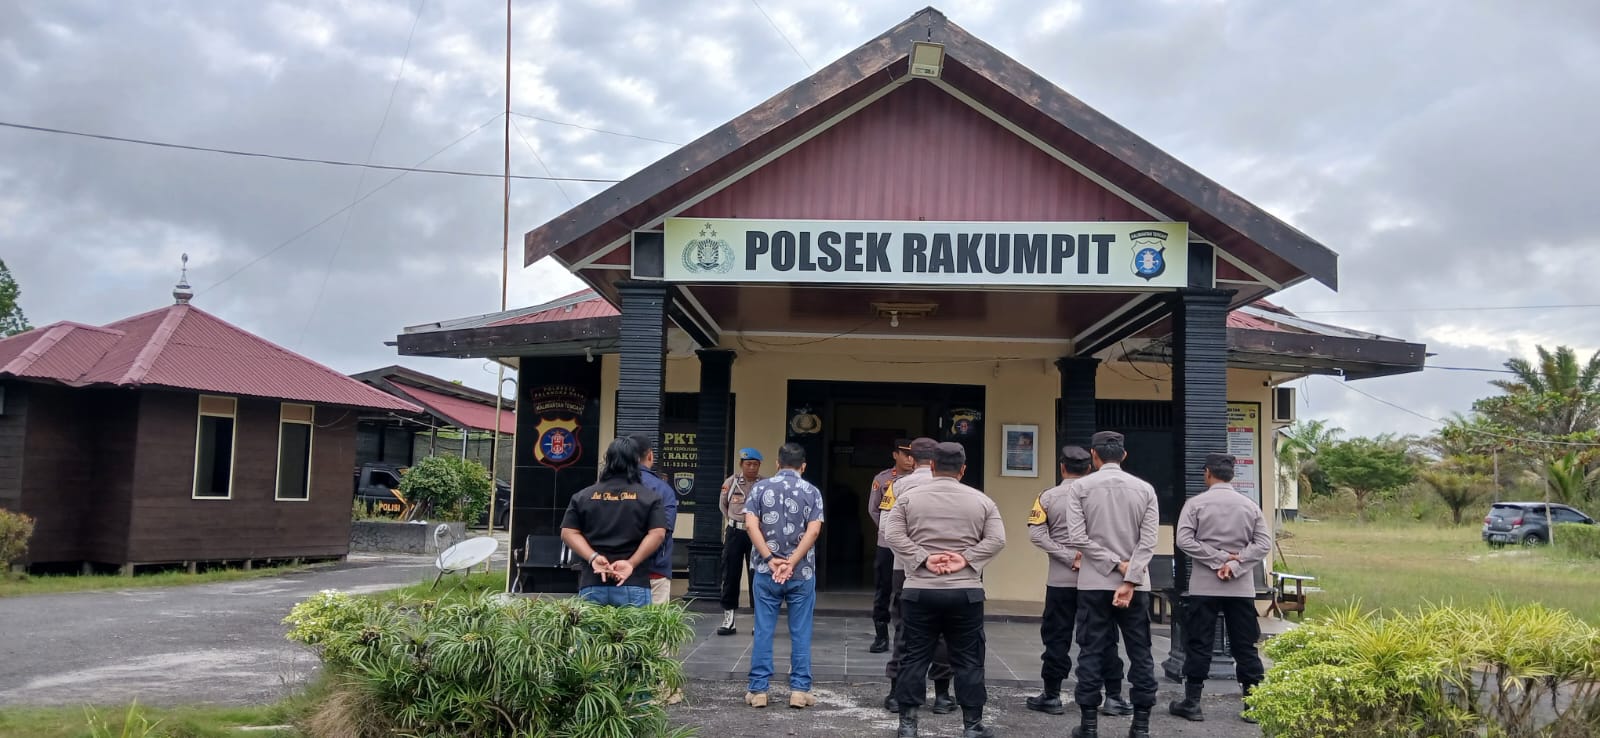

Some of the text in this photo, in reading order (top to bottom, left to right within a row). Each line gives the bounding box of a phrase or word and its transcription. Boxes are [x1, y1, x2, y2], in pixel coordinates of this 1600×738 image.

[745, 231, 1116, 275] POLSEK RAKUMPIT
[664, 432, 697, 445] PKT
[379, 503, 401, 512] POLISI
